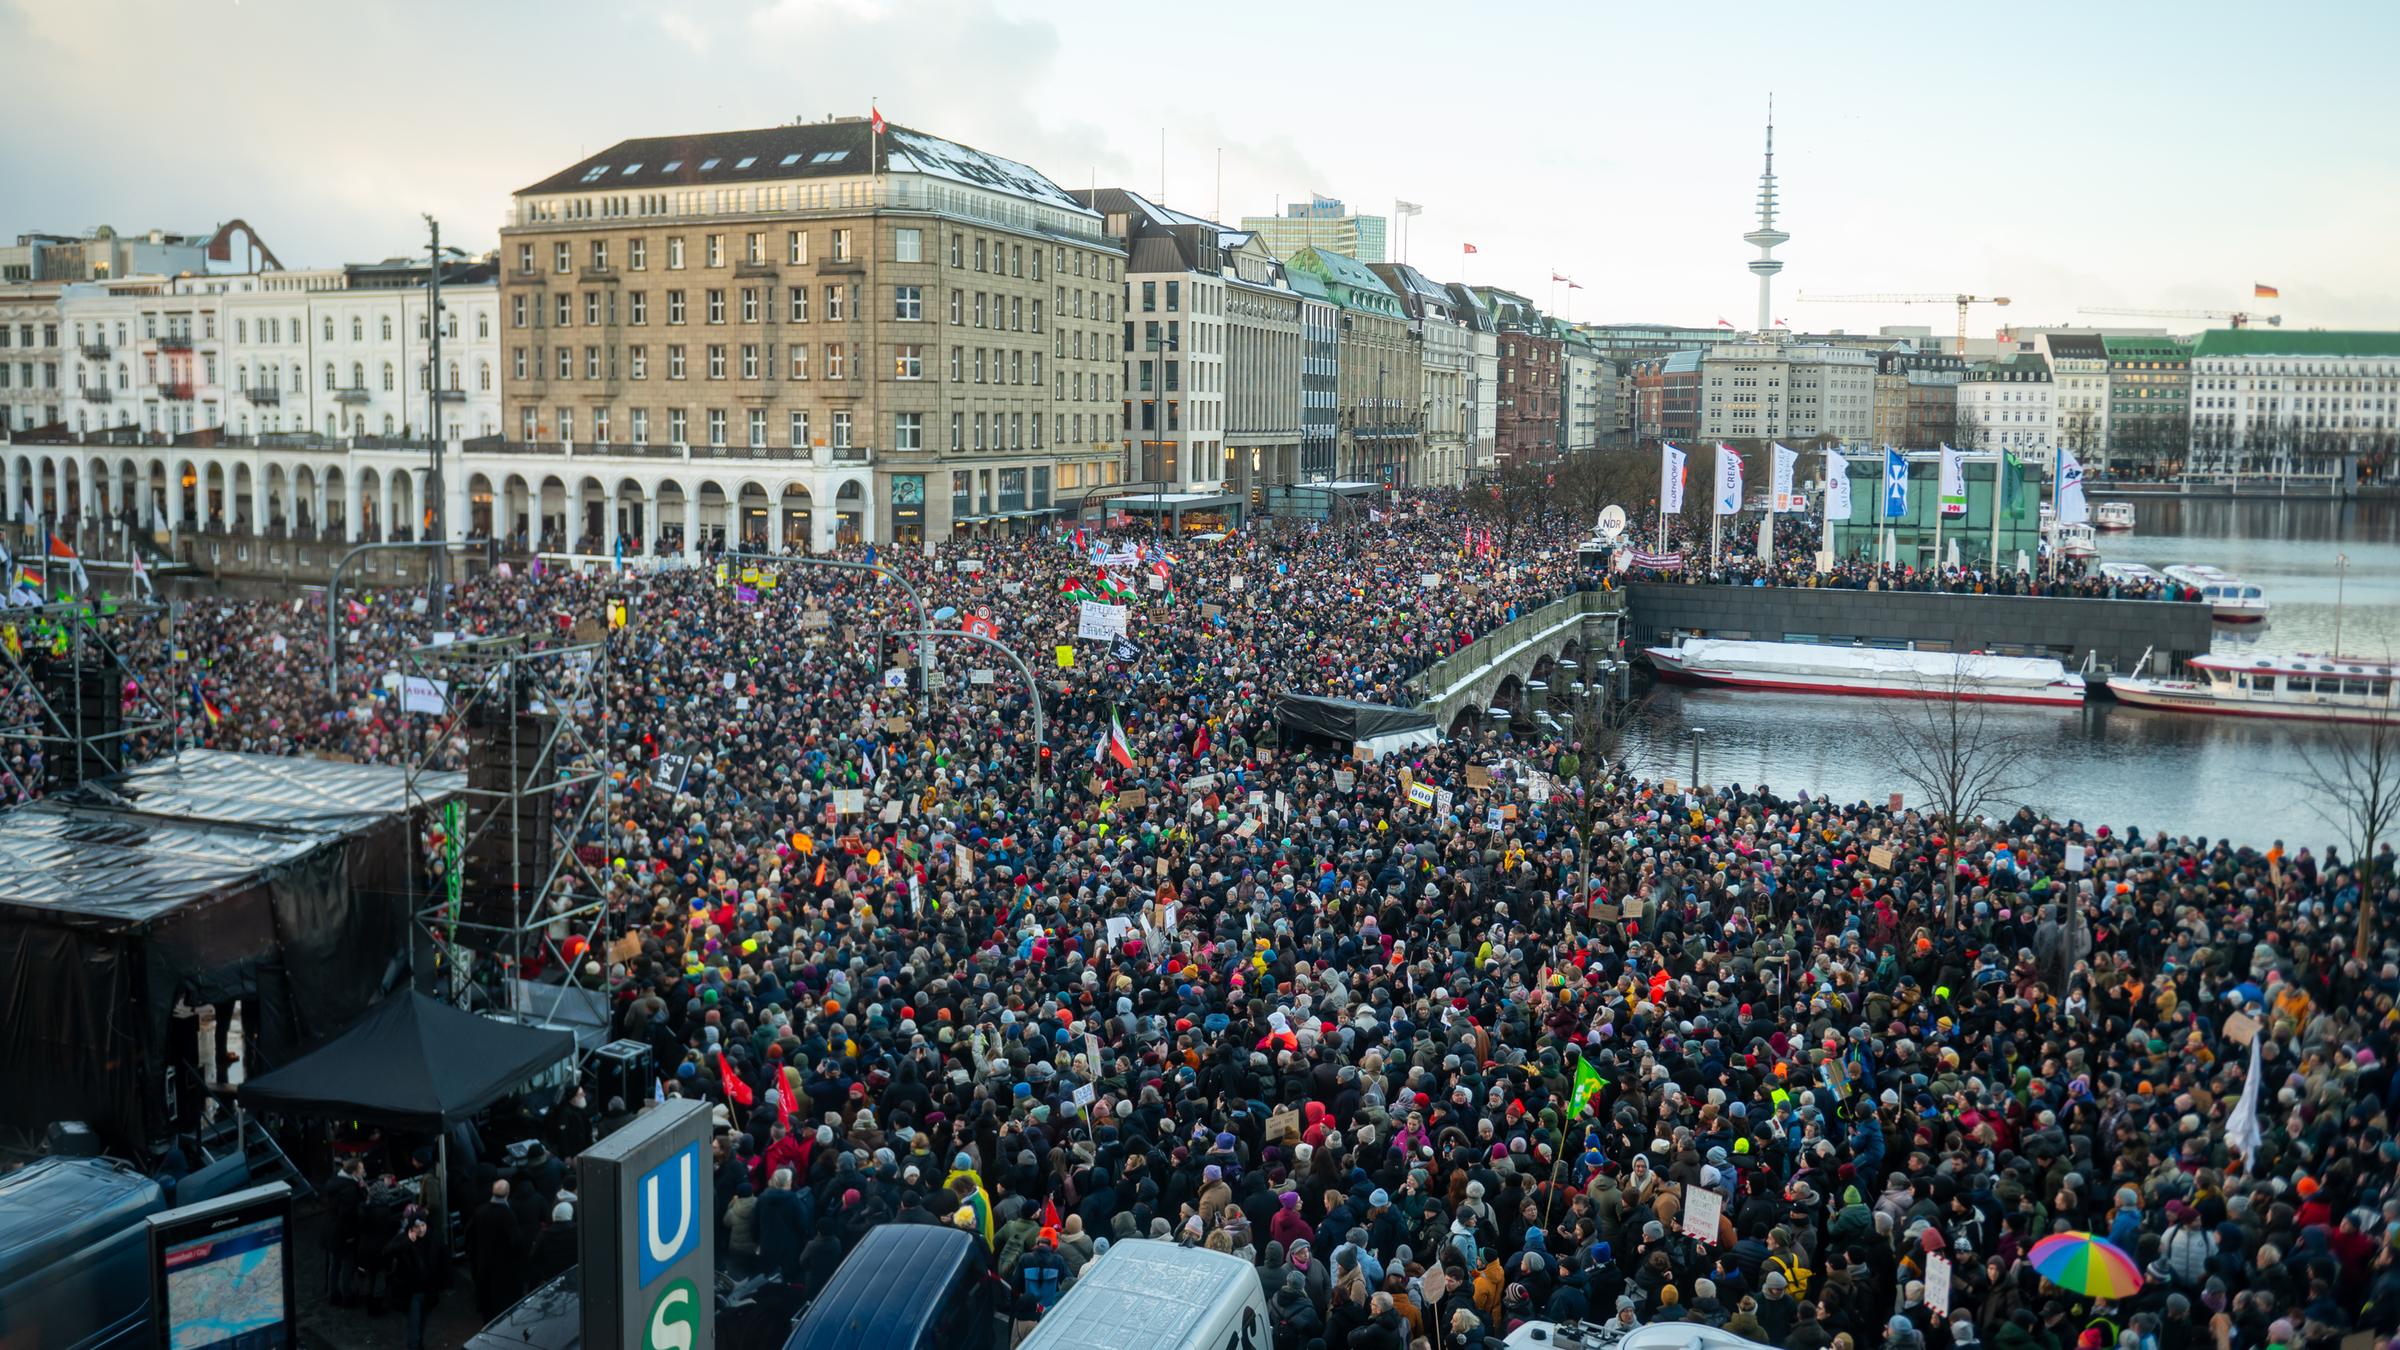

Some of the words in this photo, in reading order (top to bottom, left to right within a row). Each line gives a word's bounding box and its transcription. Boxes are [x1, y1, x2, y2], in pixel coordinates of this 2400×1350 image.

[1360, 398, 1404, 408] ALSTRHAUS
[1384, 466, 1392, 474] U
[1727, 453, 1736, 489] CREME
[1602, 519, 1621, 529] NDR
[980, 607, 988, 616] 30
[647, 1152, 691, 1262] U
[651, 1287, 692, 1350] S
